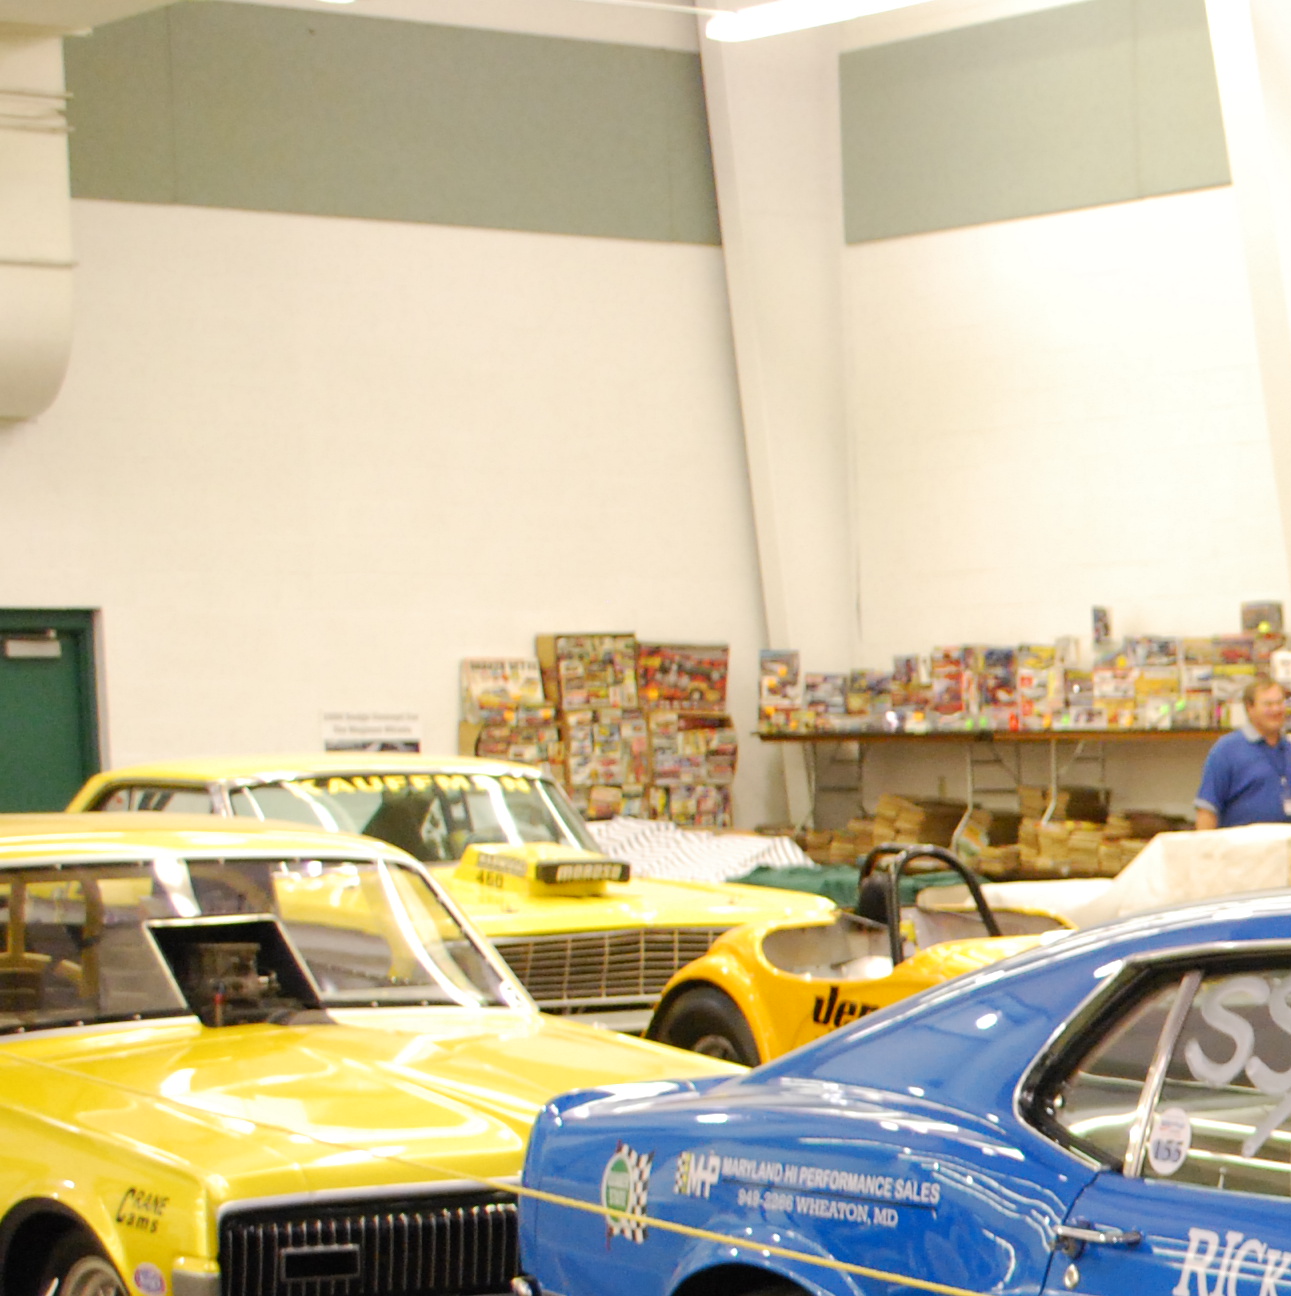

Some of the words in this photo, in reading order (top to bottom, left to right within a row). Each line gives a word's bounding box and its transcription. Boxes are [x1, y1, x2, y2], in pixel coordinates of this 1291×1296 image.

[298, 773, 531, 795] KAUFFMN
[721, 1157, 783, 1181] MARYLAND
[785, 1165, 797, 1183] HI
[798, 1167, 892, 1197] PERFORMANCE
[893, 1179, 941, 1205] SALES
[873, 1206, 899, 1228] MD
